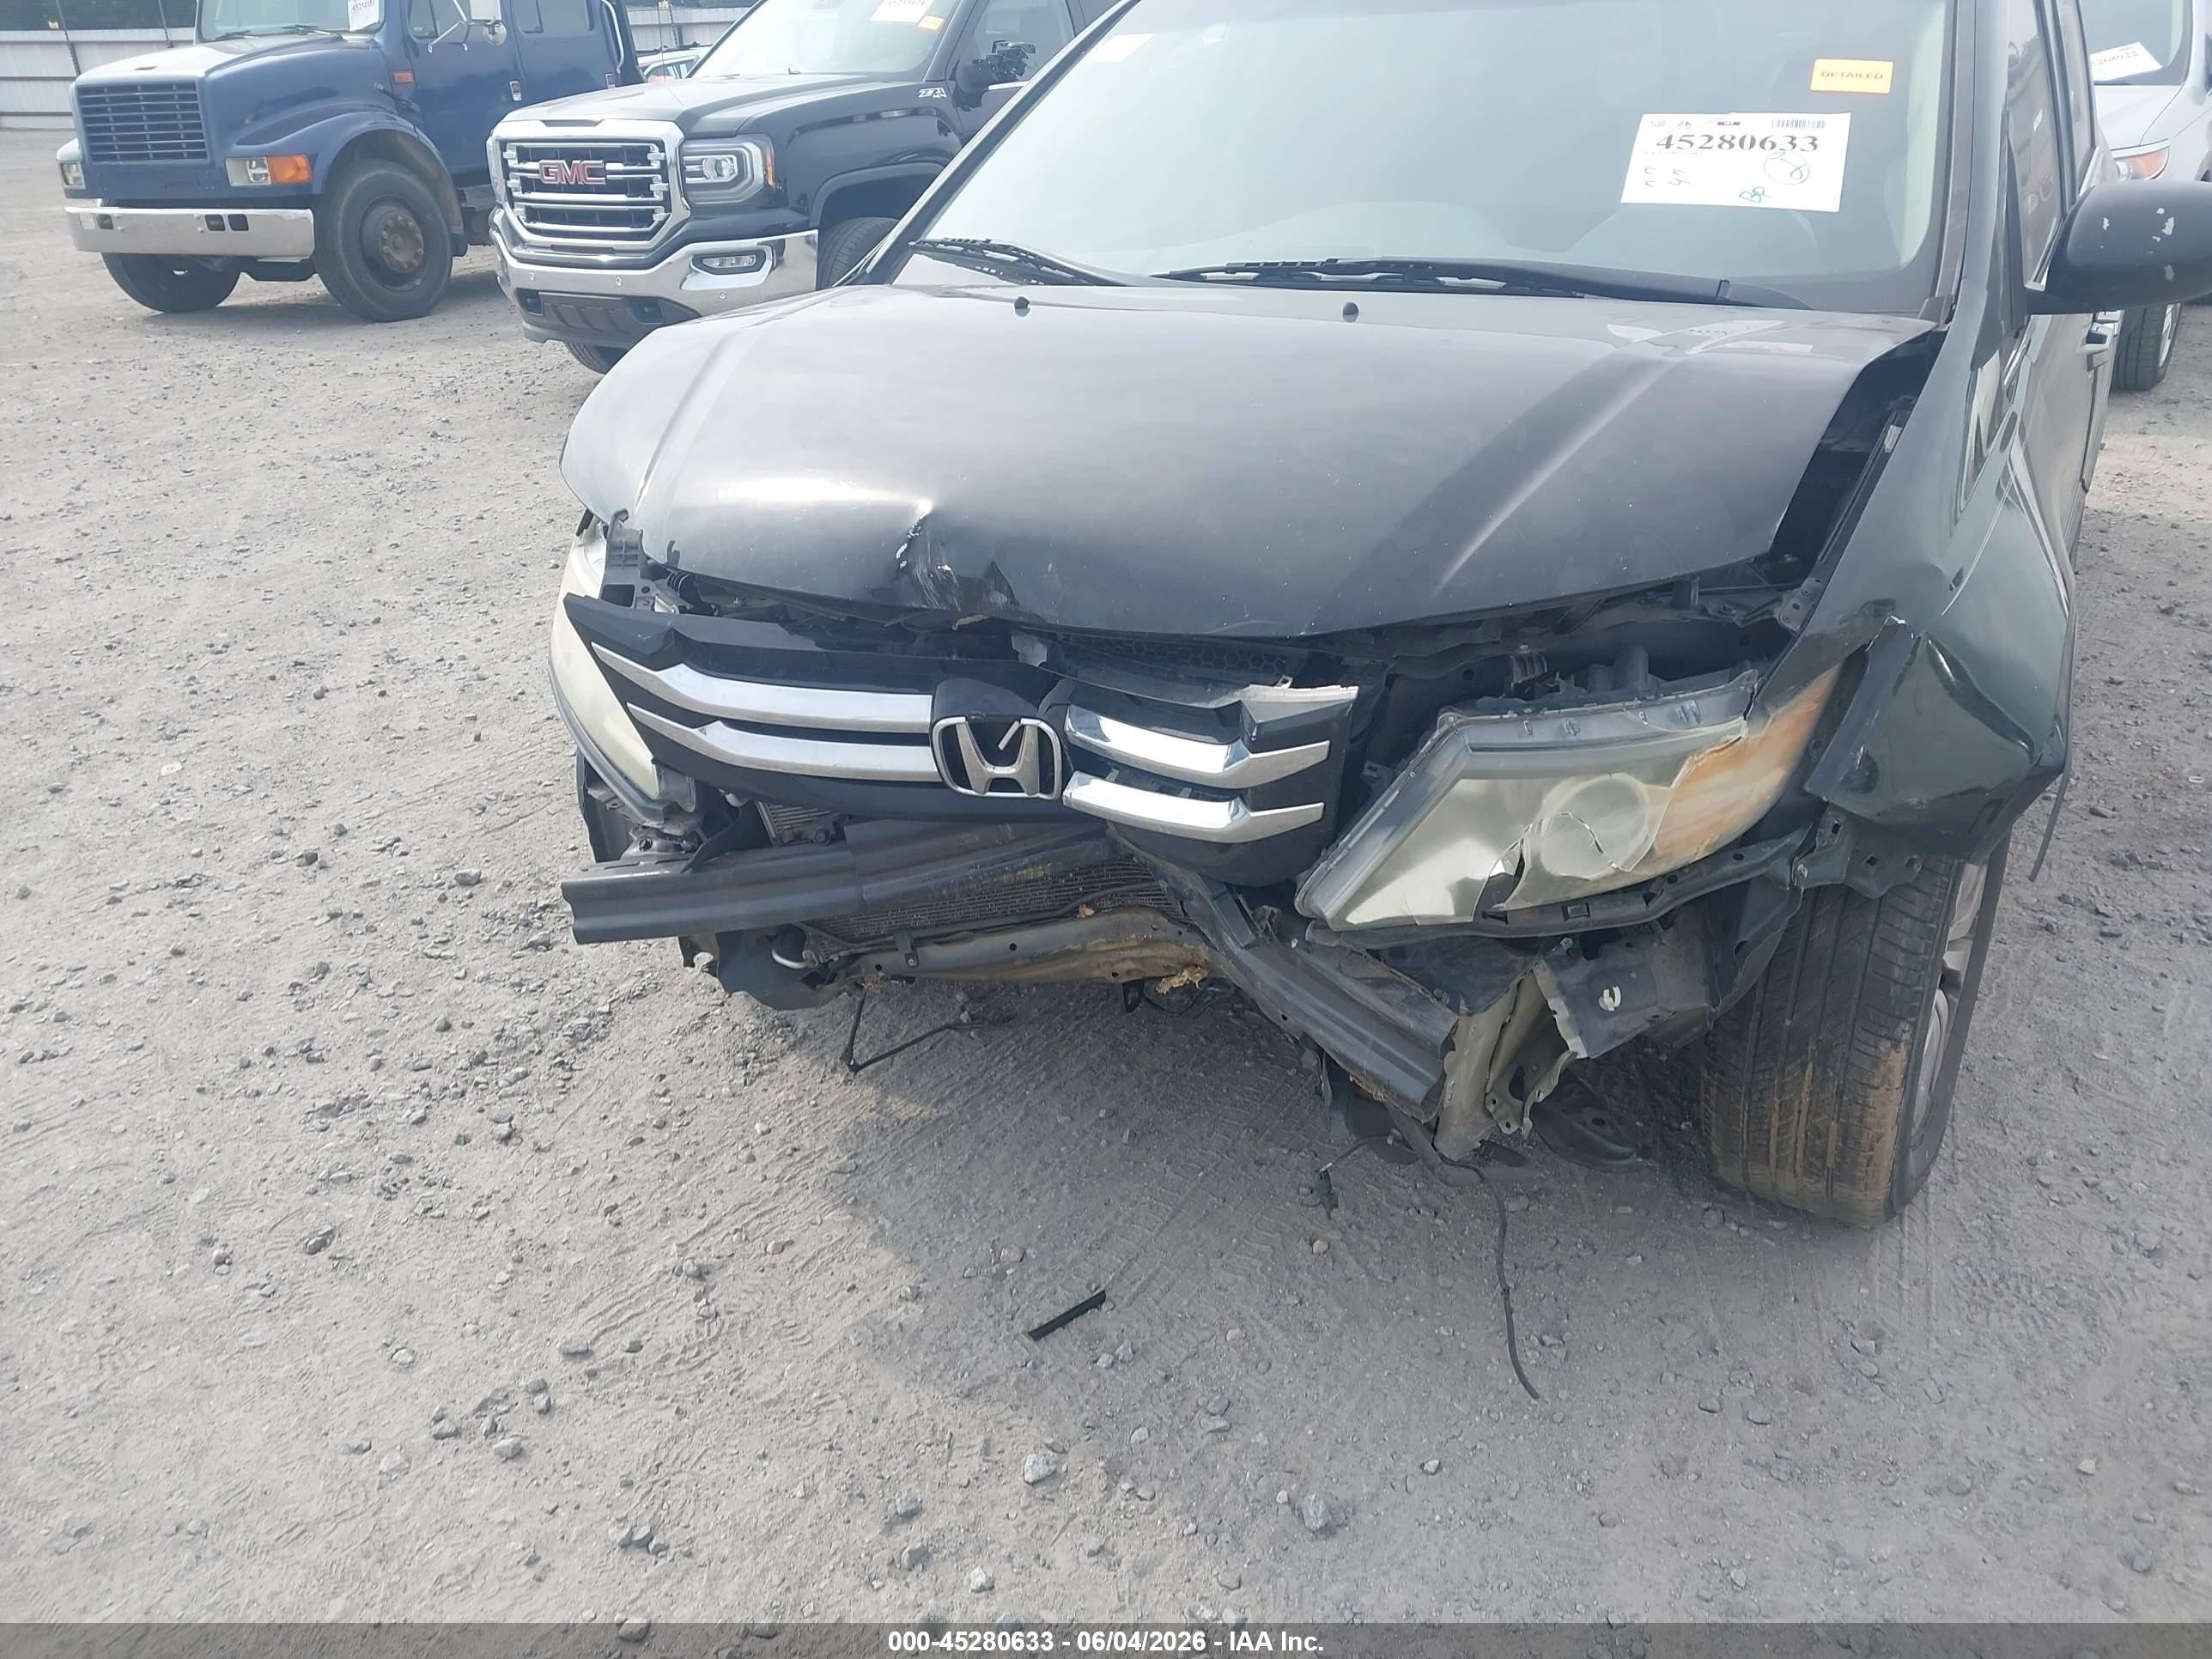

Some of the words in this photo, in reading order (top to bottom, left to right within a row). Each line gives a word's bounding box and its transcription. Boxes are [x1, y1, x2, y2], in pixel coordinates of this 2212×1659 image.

[1820, 70, 1883, 80] DETAILED
[1656, 133, 1820, 153] 45280633
[538, 159, 606, 185] GMC
